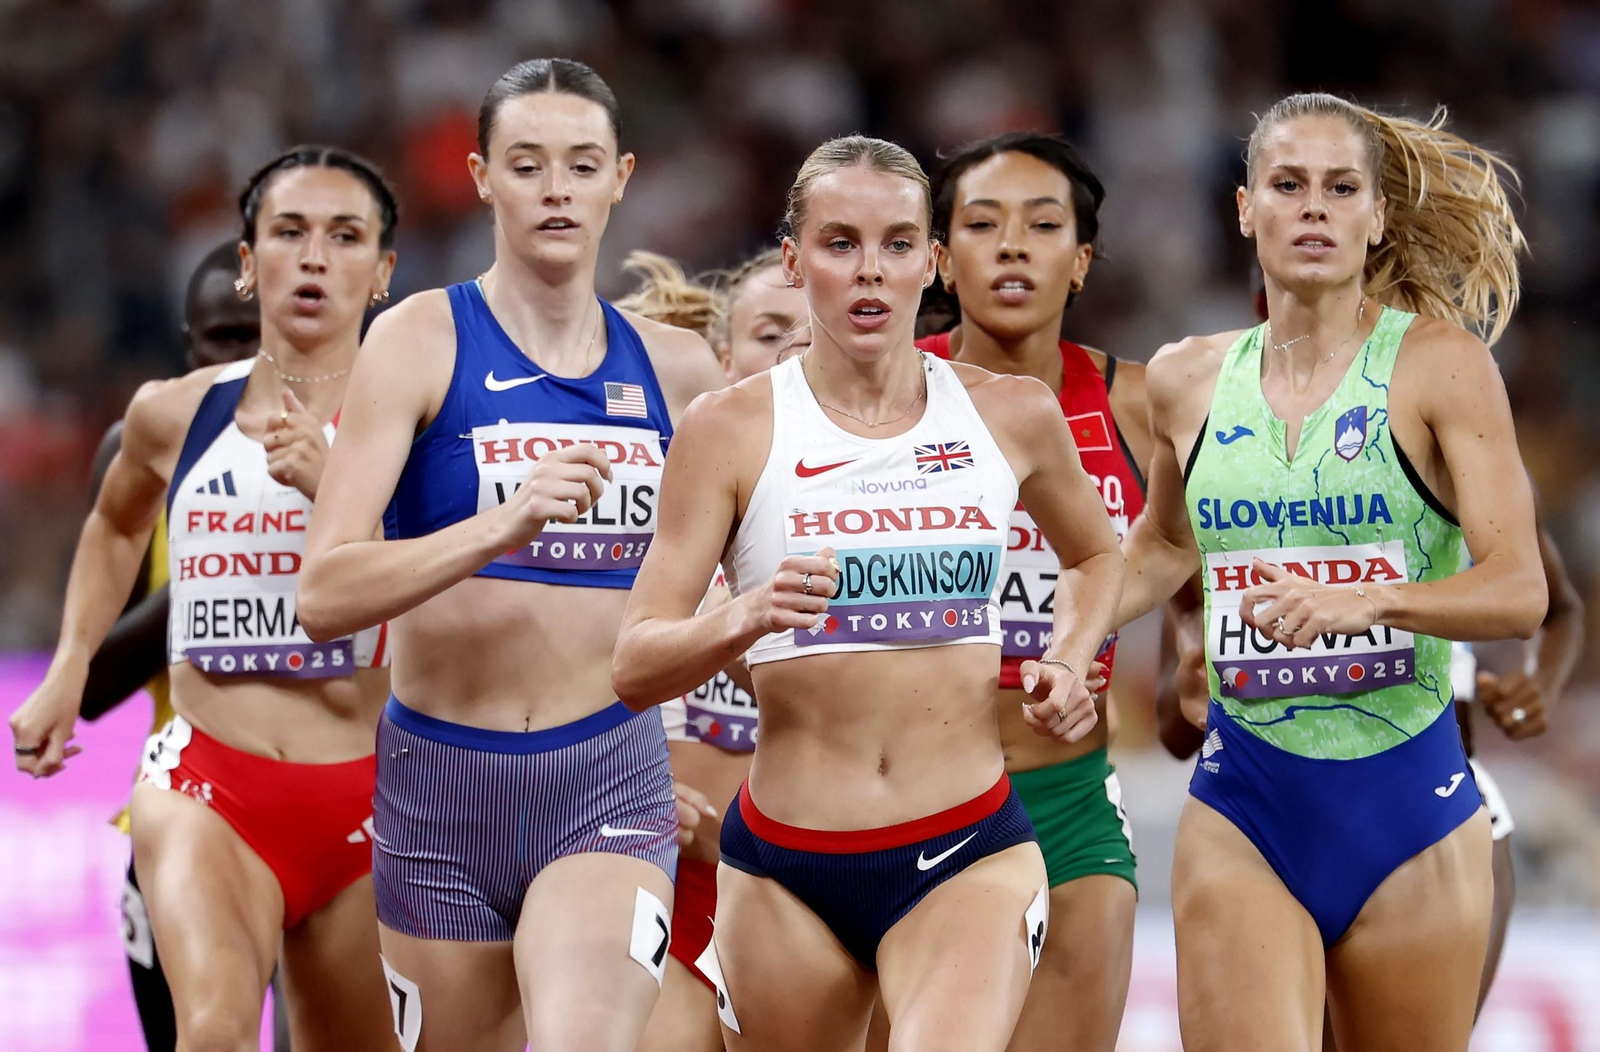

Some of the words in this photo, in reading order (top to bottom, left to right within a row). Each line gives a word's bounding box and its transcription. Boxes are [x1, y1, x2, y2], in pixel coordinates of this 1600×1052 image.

[479, 437, 661, 467] HODA
[850, 477, 928, 496] Novuna
[495, 481, 654, 527] LIS
[1198, 493, 1393, 531] SLOVENIJA
[187, 509, 307, 534] FRANC
[789, 505, 997, 538] HONDA
[179, 551, 302, 581] HOND
[184, 597, 301, 640] IBERM
